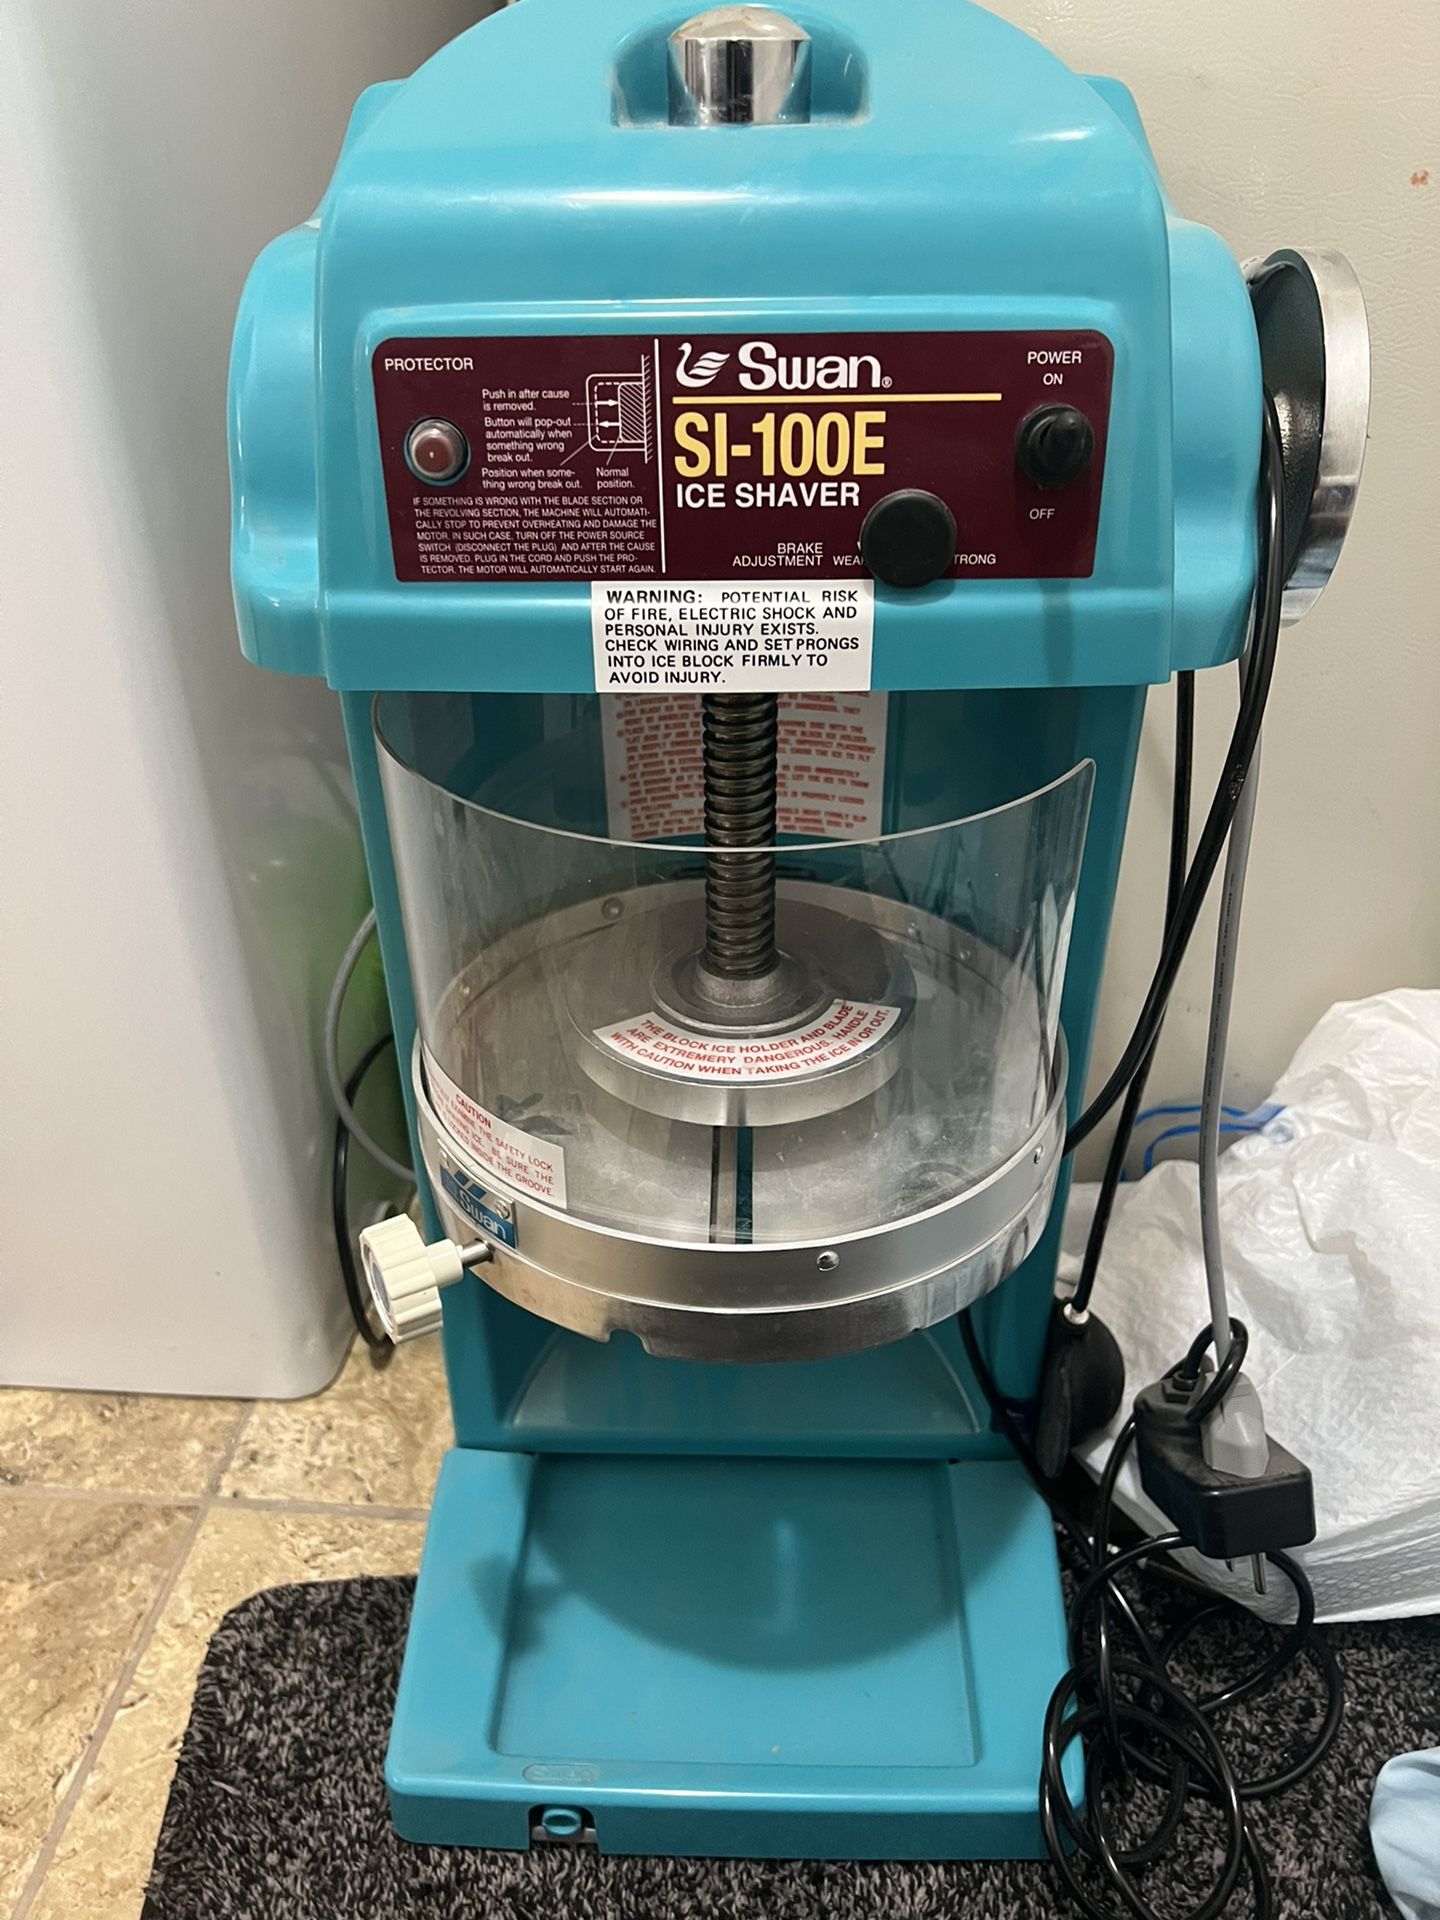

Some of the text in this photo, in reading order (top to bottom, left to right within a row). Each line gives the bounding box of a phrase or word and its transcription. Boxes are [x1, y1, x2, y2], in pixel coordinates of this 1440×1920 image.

[384, 357, 474, 371] PROTECTOR
[1027, 351, 1082, 365] POWER
[1043, 373, 1064, 386] ON
[482, 389, 569, 398] Push in after cause
[483, 402, 536, 411] is removed.
[485, 417, 571, 429] Button will pop-out
[486, 430, 544, 440] automatically
[486, 442, 564, 452] something wrong
[674, 410, 887, 478] SI-100E
[488, 453, 532, 462] break out.
[482, 468, 575, 477] Position when some-
[597, 468, 629, 477] Normal
[482, 480, 582, 491] thing wrong break out.
[597, 480, 635, 491] position.
[413, 496, 643, 505] IF SOMETHING IS WRONG WITH THE BLADE SECTION OR
[676, 482, 860, 508] ICE SHAVER
[415, 509, 431, 517] THE
[433, 509, 480, 517] REVOLVING
[523, 508, 539, 517] THE
[542, 508, 579, 516] MACHINE
[582, 508, 602, 516] WILL
[604, 508, 650, 516] AUTOMATI-
[1029, 508, 1055, 520] OFF
[416, 521, 442, 529] CALLY
[445, 521, 466, 529] STOP
[522, 520, 580, 528] OVERHEATING
[583, 520, 600, 528] AND
[452, 532, 460, 540] IN
[463, 532, 486, 540] SUCH
[541, 531, 556, 539] OFF
[559, 531, 575, 539] THE
[577, 531, 607, 539] POWER
[610, 531, 644, 539] SOURCE
[455, 543, 511, 552] (DISCONNECT
[514, 543, 529, 551] THE
[561, 543, 579, 551] AND
[581, 543, 606, 551] AFTER
[609, 543, 625, 551] THE
[627, 543, 655, 551] CAUSE
[778, 543, 823, 554] BRAKE
[474, 554, 497, 562] PLUG
[500, 554, 508, 562] IN
[510, 554, 526, 562] THE
[528, 554, 552, 562] CORD
[554, 554, 572, 562] AND
[574, 554, 597, 562] PUSH
[599, 554, 615, 562] THE
[617, 554, 637, 562] PRO-
[732, 555, 823, 567] ADJUSTMENT
[833, 555, 864, 566] WEA
[953, 554, 996, 565] TRONG
[530, 565, 598, 573] AUTOMATICALLY
[600, 565, 626, 573] START
[628, 565, 656, 573] AGAIN.
[607, 590, 858, 603] WARNING: POTENTIAL RISK
[605, 607, 857, 622] OF FIRE, ELECTRIC SHOCK AND
[606, 623, 818, 636] PERSONAL INJURY EXISTS.
[606, 638, 859, 651] CHECK WIRING AND SET PRONGS
[608, 654, 828, 667] INTO ICE BLOCK FIRMLY TO
[610, 672, 725, 683] AVOID INJURY.
[641, 1004, 853, 1053] THE BLOCK ICE HOLDER AND BLADE
[610, 1009, 890, 1075] WITH CAUTION WHEN TAKING THE ICE IN OR OUT.
[627, 1010, 869, 1063] ARE EXTREMERY DANGEROUS. HANDLE
[456, 1094, 491, 1128] CAUTION
[479, 1126, 492, 1142] THE
[495, 1138, 525, 1158] SAFETY
[529, 1156, 553, 1172] LOCK
[497, 1161, 512, 1177] THE
[506, 1156, 528, 1174] SURE
[536, 1170, 553, 1185] THE
[460, 1189, 506, 1240] Swan
